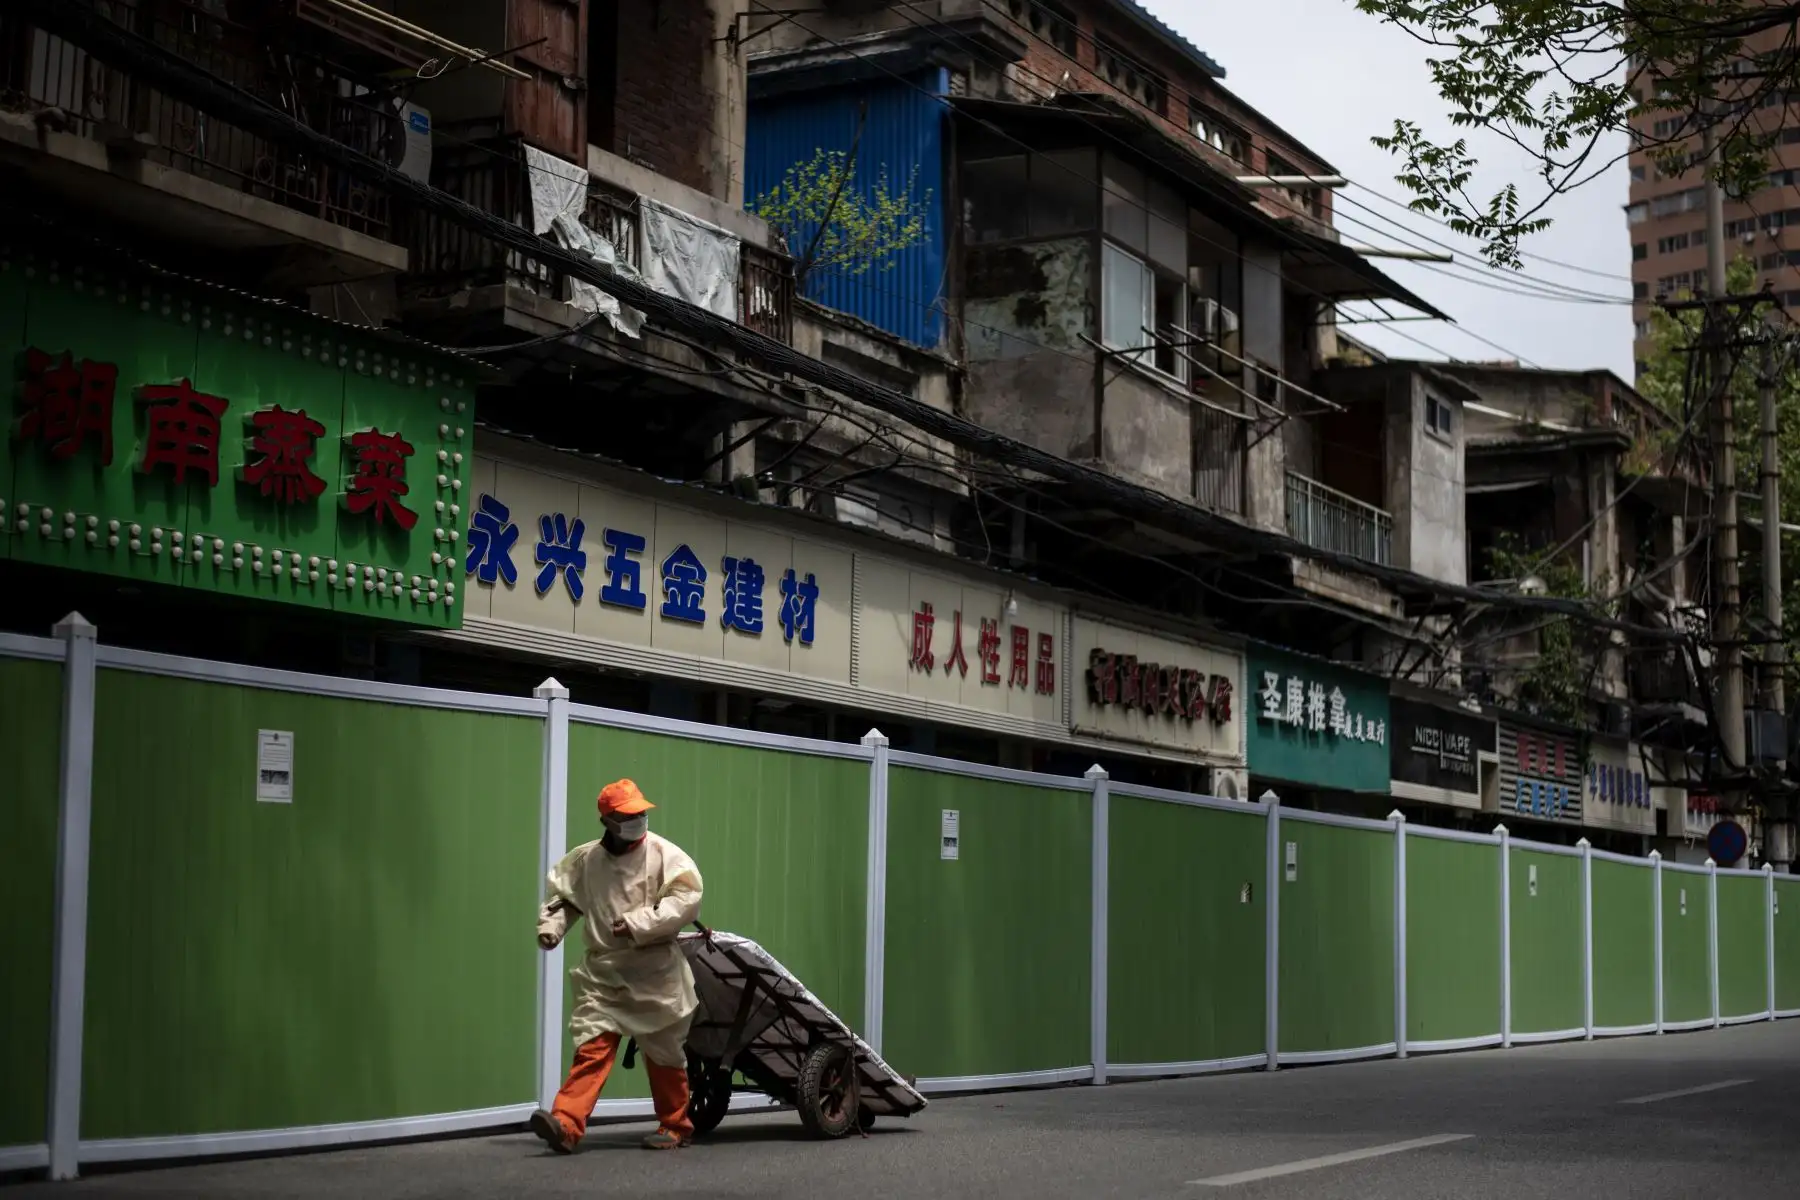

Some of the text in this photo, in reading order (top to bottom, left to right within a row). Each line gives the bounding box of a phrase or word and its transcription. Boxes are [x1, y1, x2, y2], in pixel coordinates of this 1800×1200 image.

[14, 346, 419, 531] 湖南蒸菜
[466, 493, 819, 644] 永兴五金建材
[909, 601, 1055, 696] 成人性用品
[1262, 670, 1347, 736] 圣康推拿
[1444, 732, 1471, 755] VAPE
